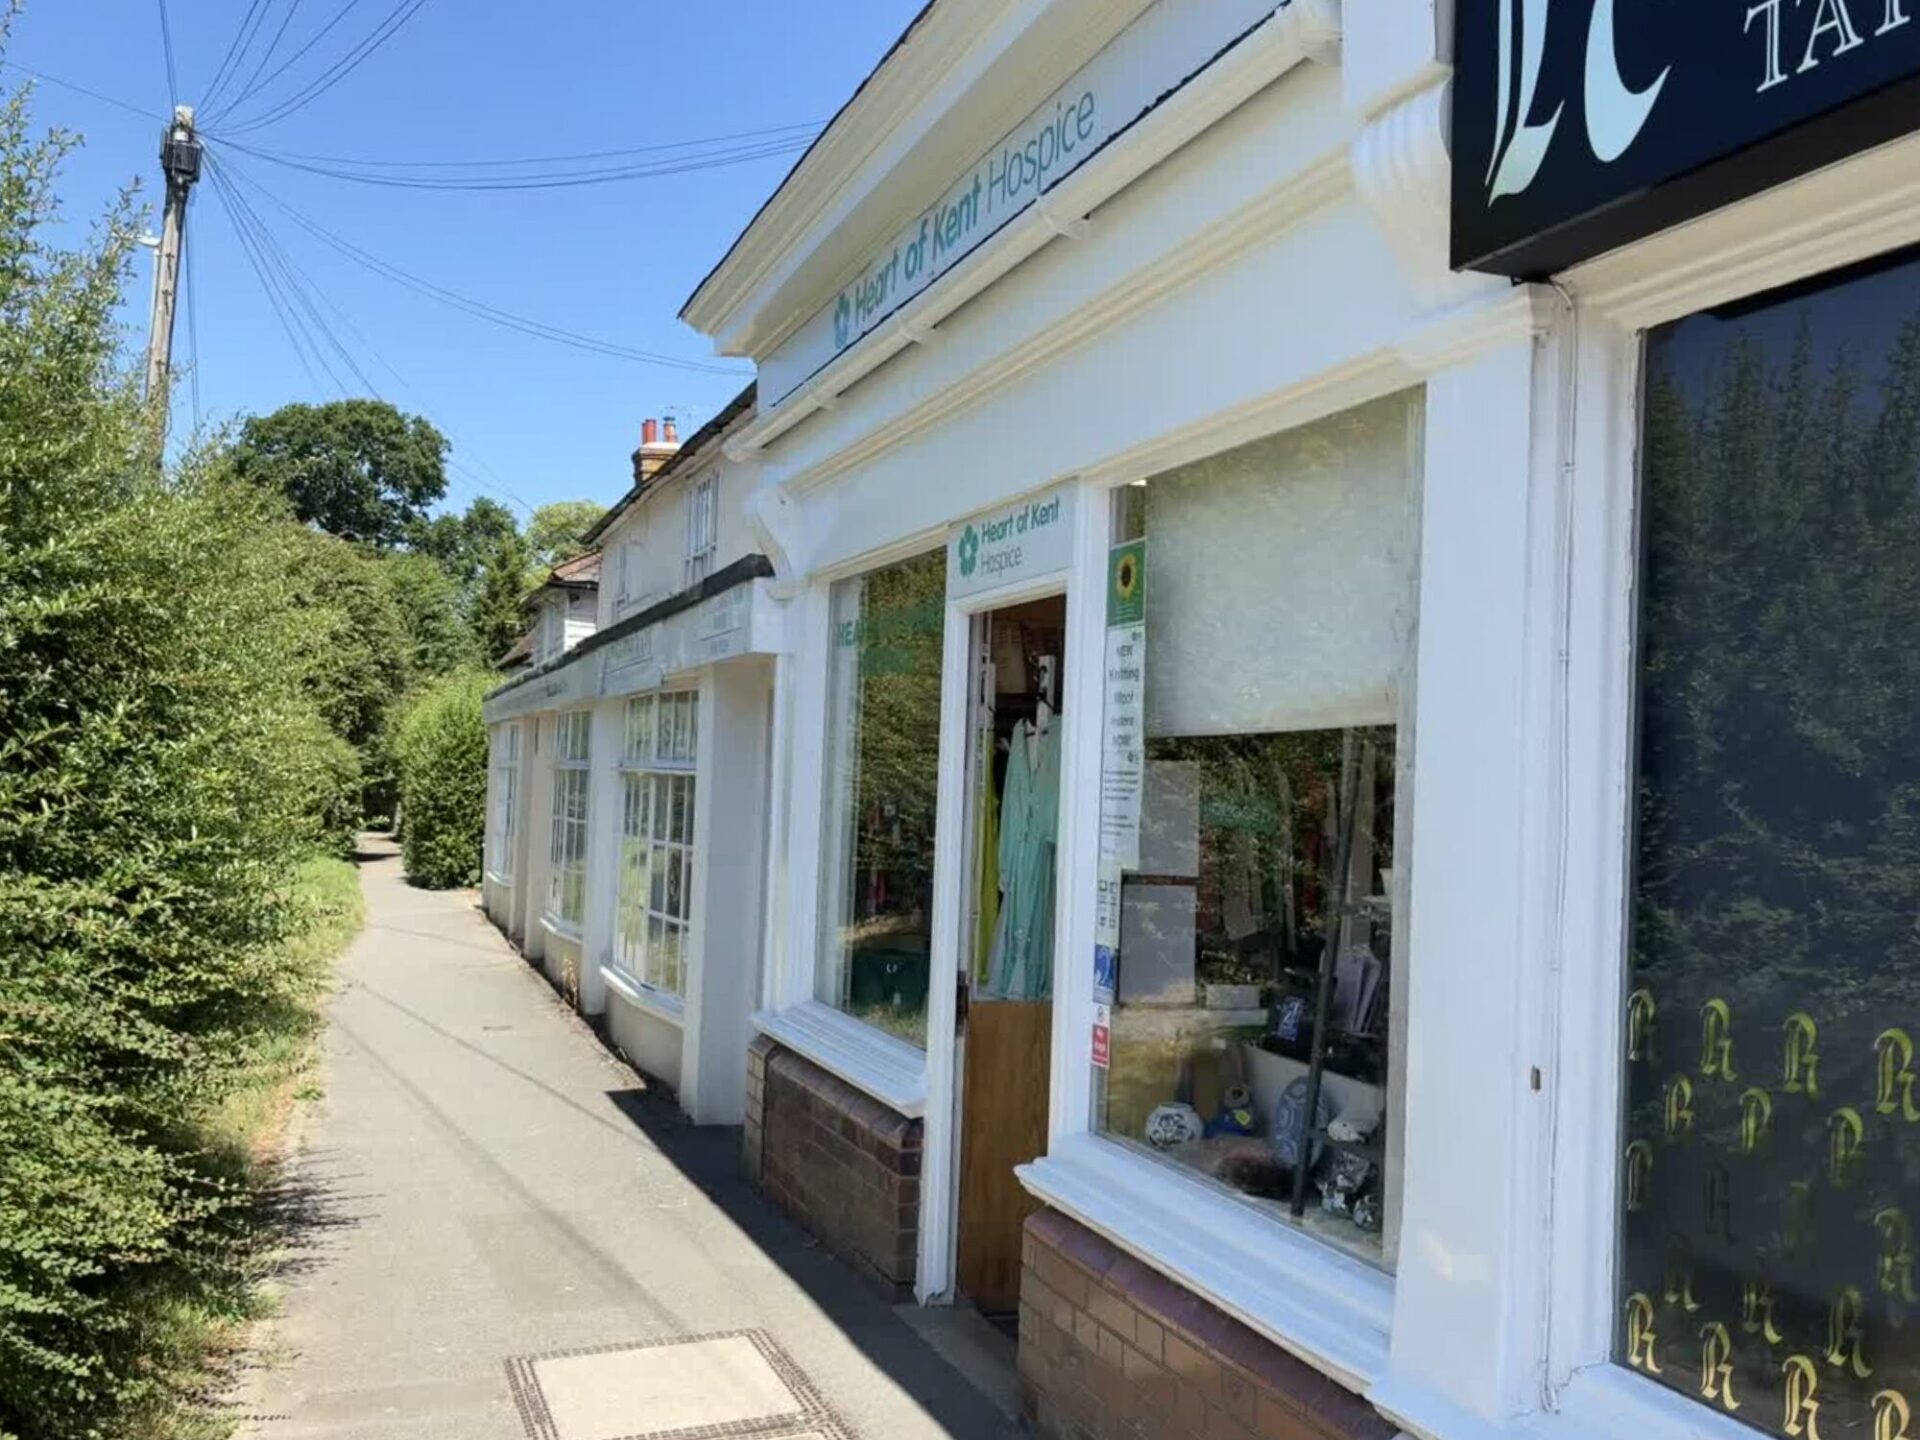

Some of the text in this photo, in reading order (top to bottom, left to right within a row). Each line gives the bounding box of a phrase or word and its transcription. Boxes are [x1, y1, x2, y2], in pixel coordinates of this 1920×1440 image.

[855, 91, 1096, 327] Heart of Kent Hospice
[981, 495, 1061, 544] Heart of Kent
[980, 545, 1023, 577] Hospice
